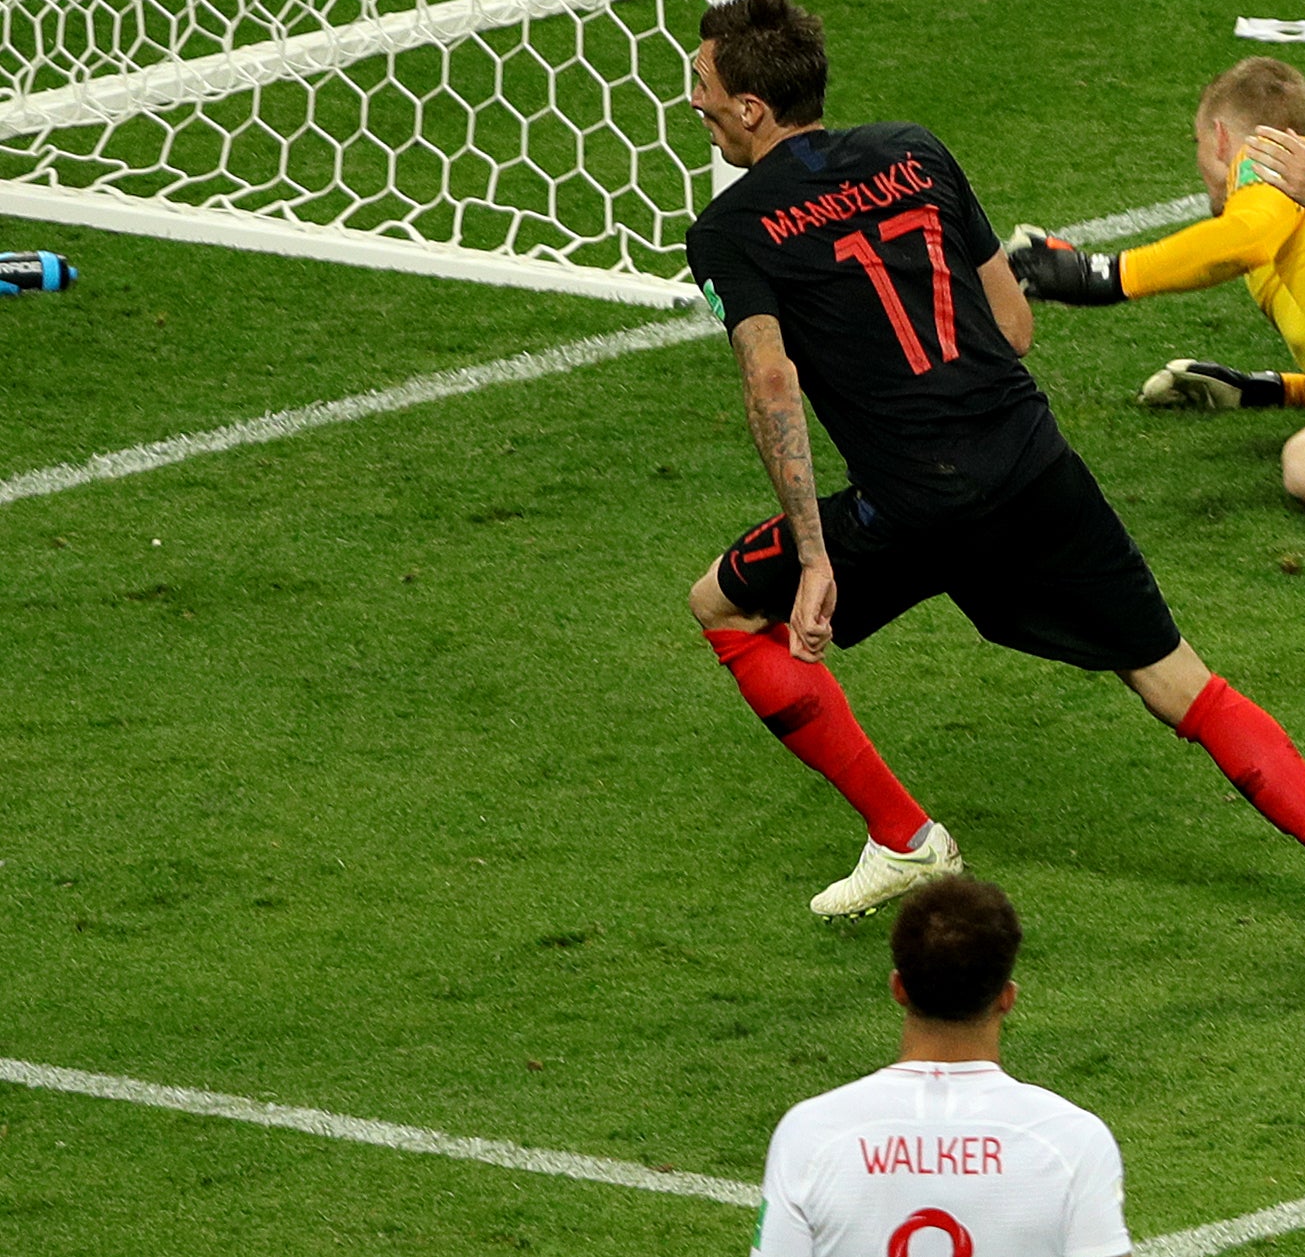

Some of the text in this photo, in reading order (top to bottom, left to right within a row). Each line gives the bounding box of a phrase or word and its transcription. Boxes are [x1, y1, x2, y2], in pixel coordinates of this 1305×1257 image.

[760, 151, 934, 245] MANDŽUKIĆ
[833, 203, 960, 376] 17
[859, 1135, 1003, 1176] WALKER
